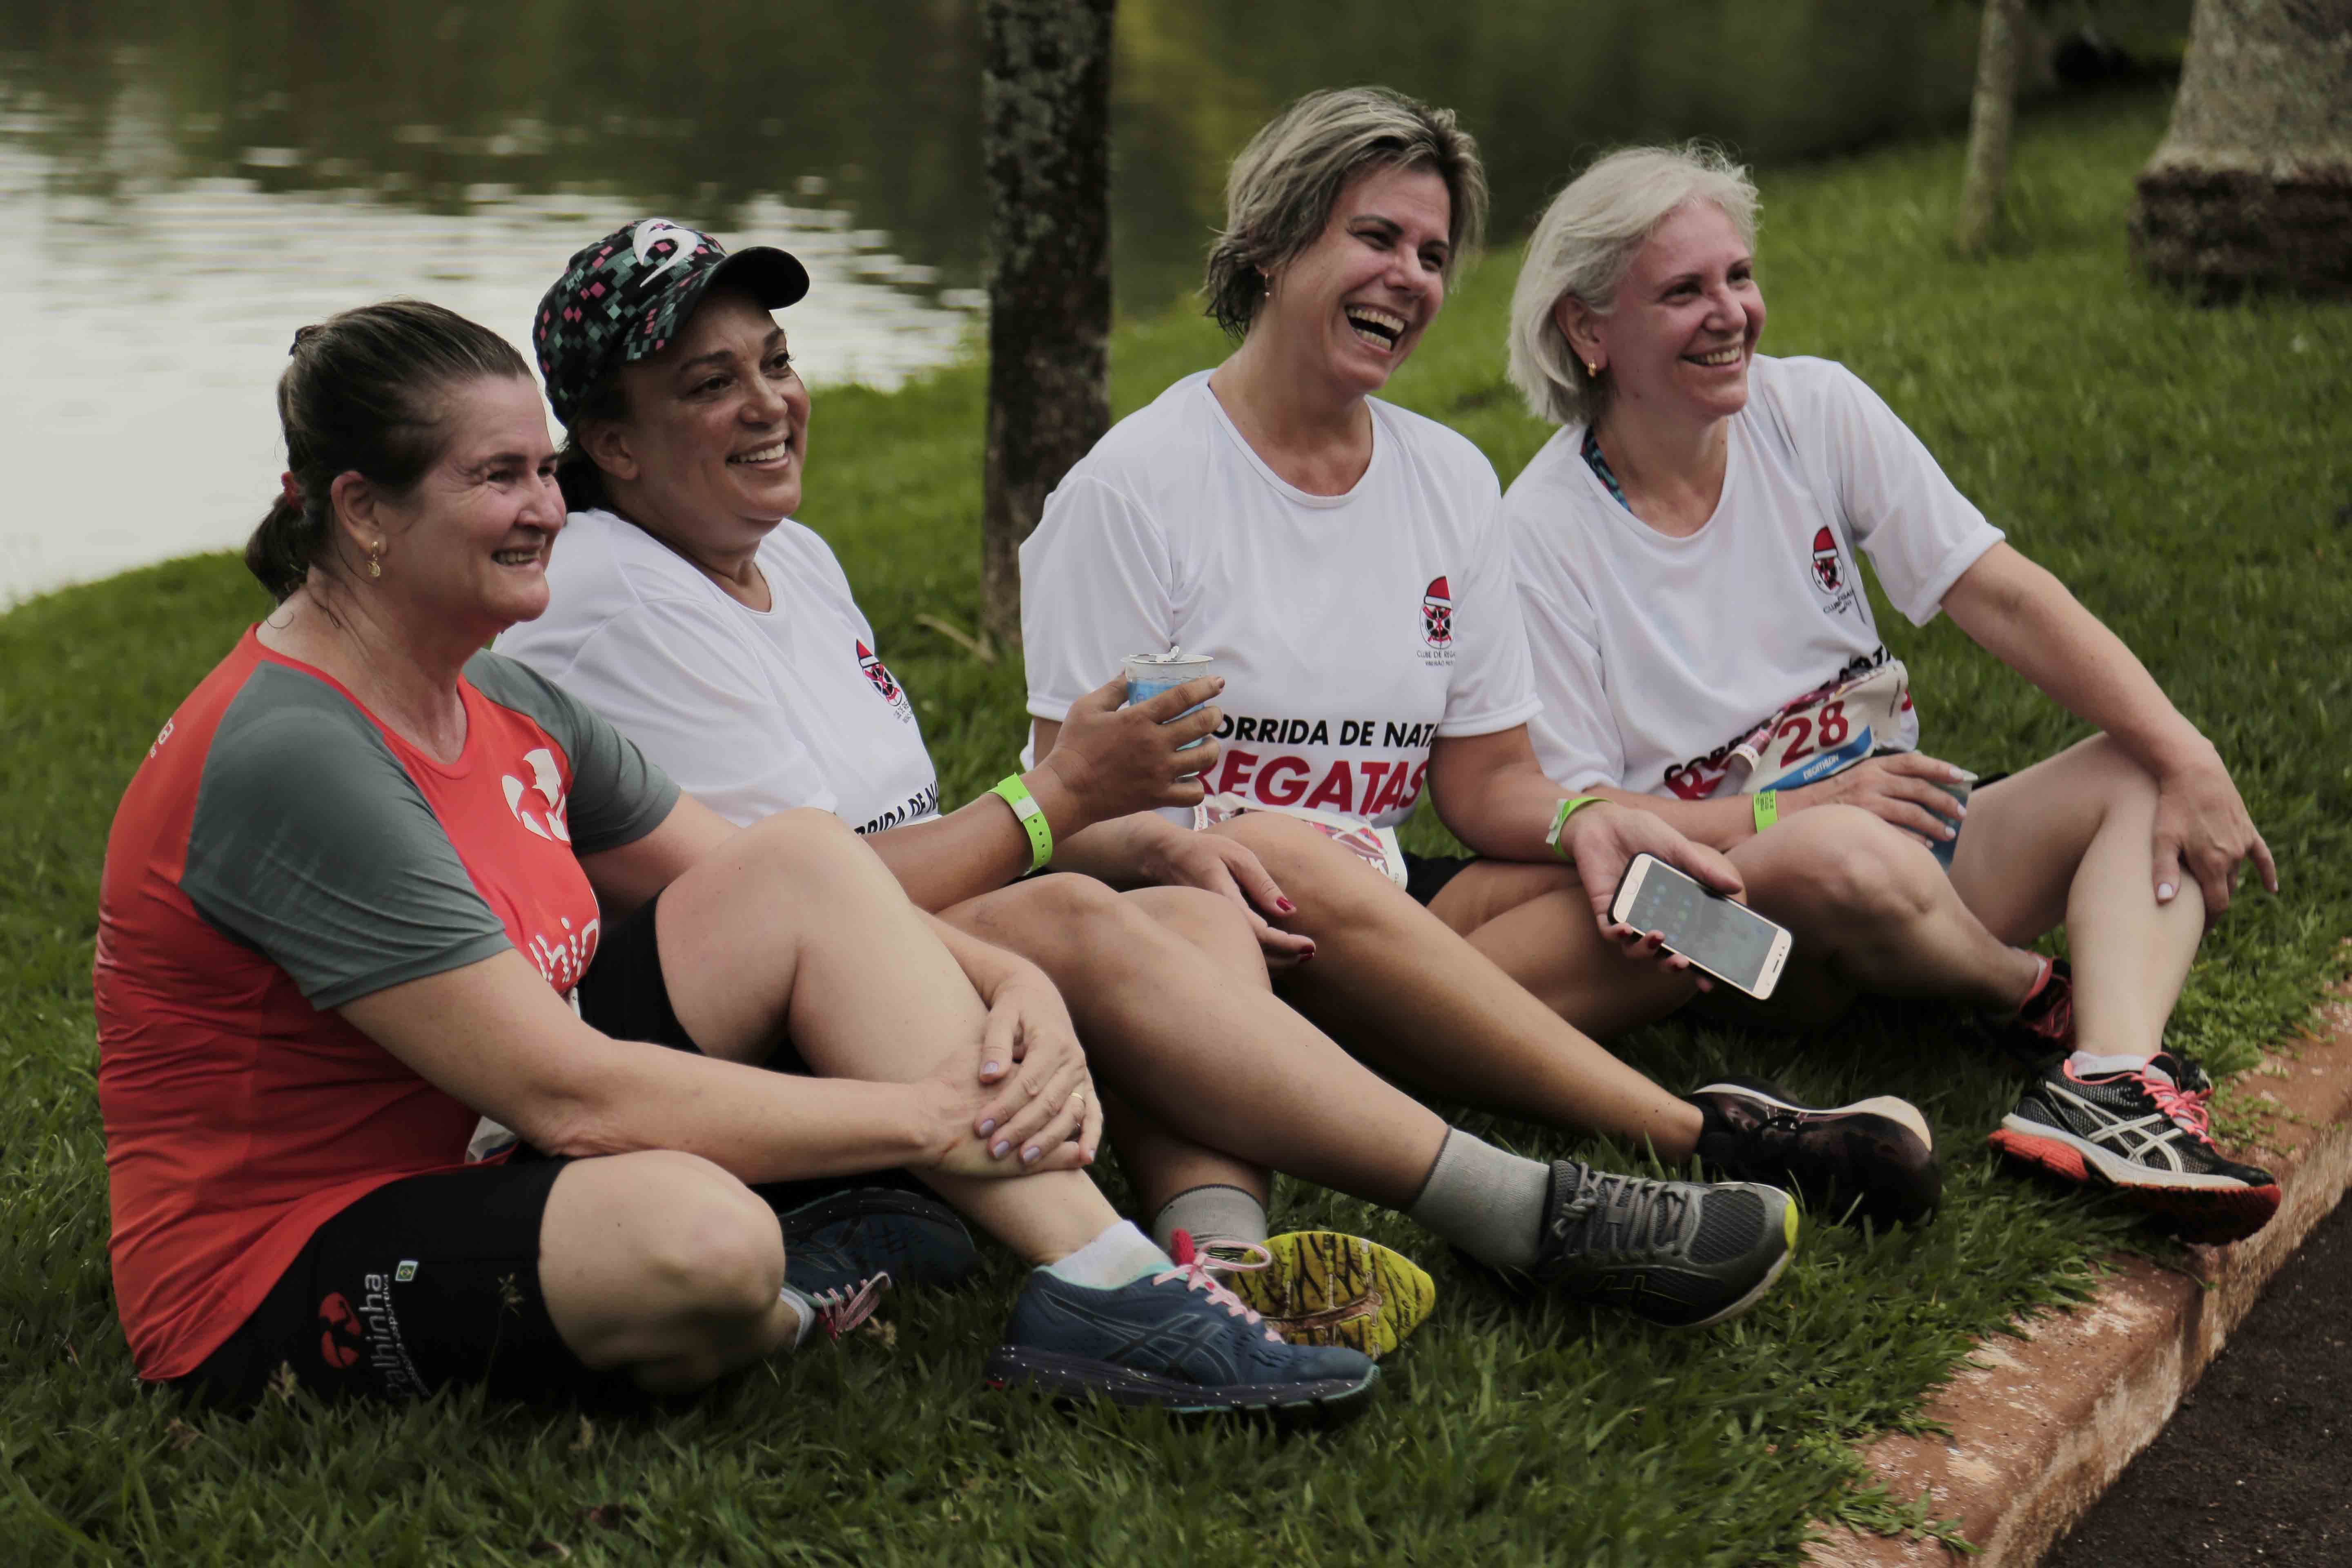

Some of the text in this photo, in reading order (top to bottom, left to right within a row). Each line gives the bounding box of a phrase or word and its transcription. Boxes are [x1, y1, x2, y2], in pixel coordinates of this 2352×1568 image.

[1339, 720, 1375, 746] DE
[1777, 700, 1849, 769] 28
[908, 793, 926, 816] DE
[359, 1274, 412, 1397] alhinha
